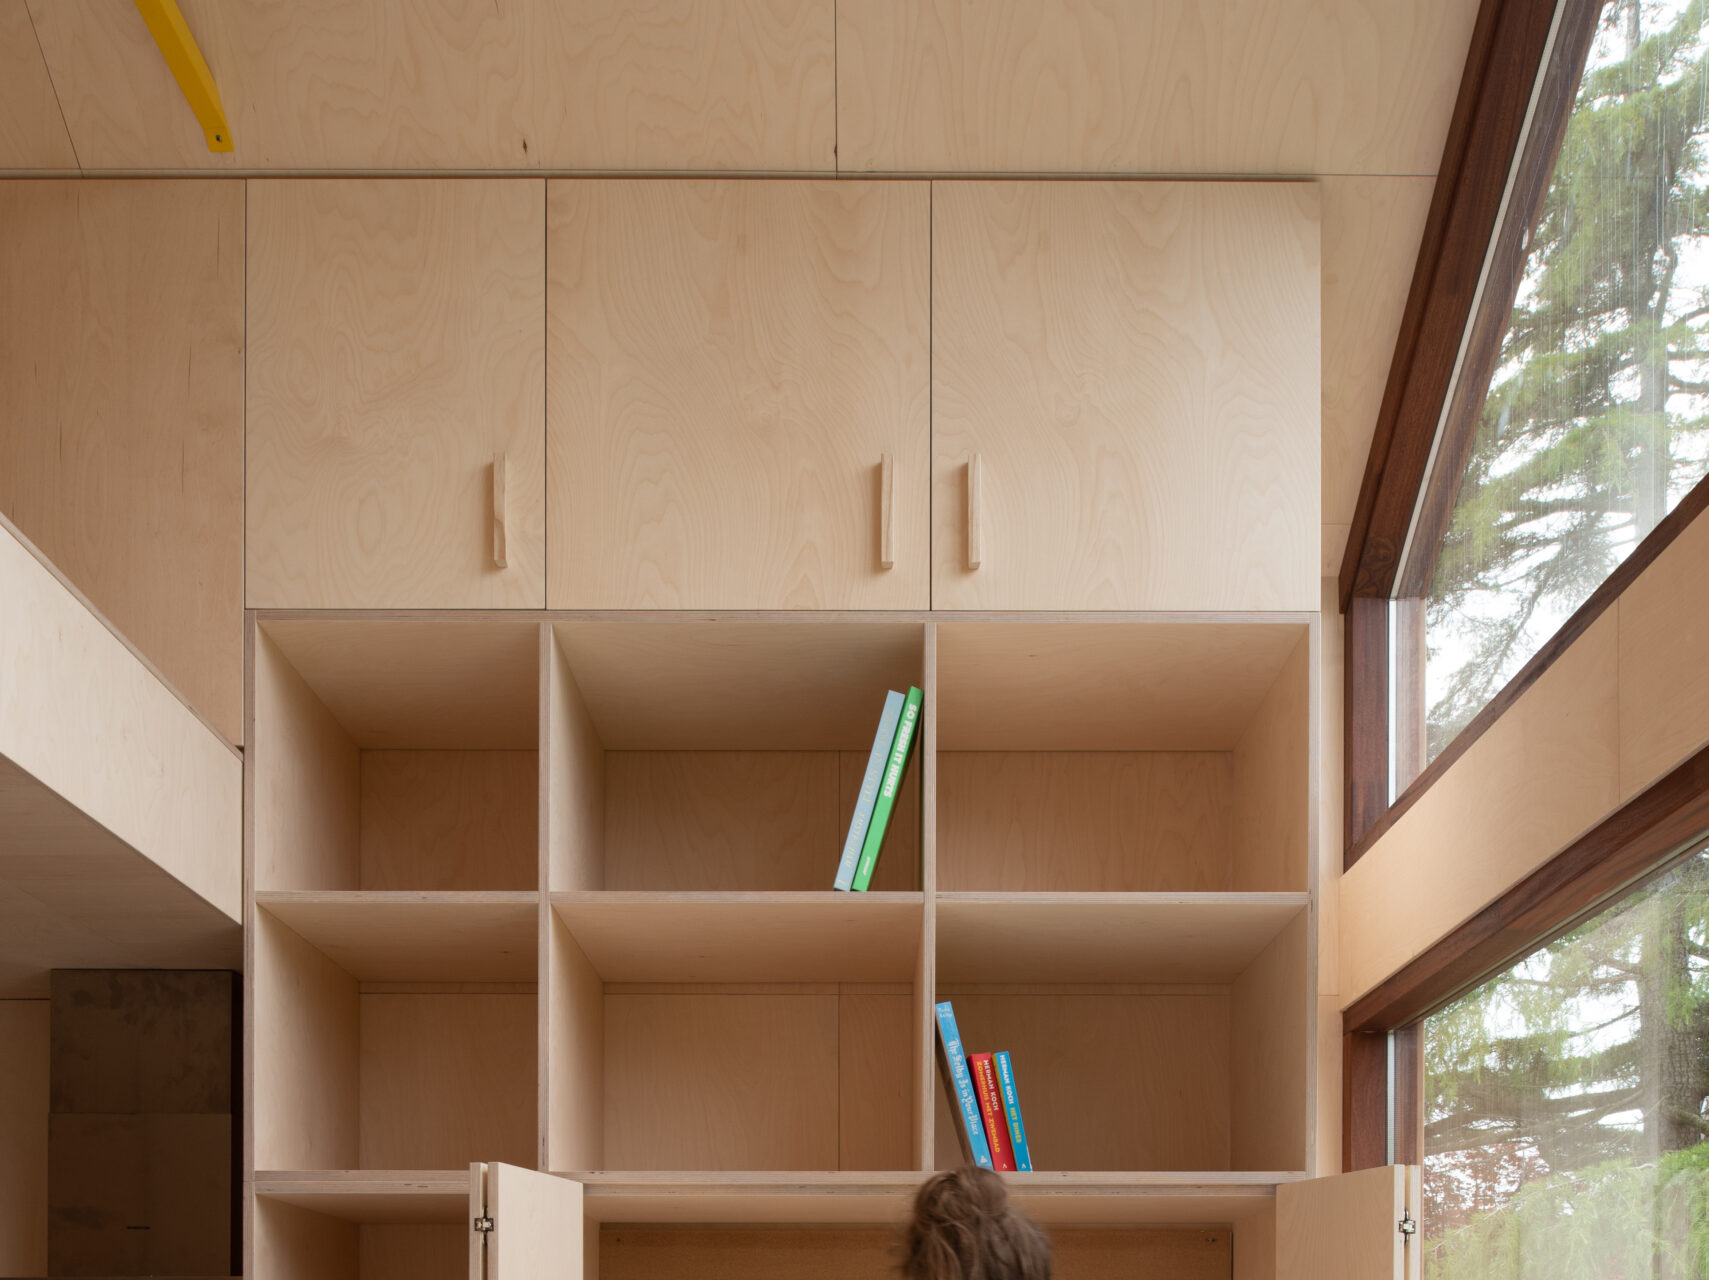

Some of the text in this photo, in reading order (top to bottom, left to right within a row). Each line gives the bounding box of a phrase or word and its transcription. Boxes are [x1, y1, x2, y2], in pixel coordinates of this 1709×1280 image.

[906, 703, 917, 720] SO
[896, 720, 914, 753] FRESH
[883, 763, 901, 798] HURTS
[983, 1059, 1000, 1111] HERMAN KOCH
[999, 1054, 1010, 1084] HERMAN
[1005, 1085, 1015, 1105] KOCH
[1012, 1121, 1022, 1144] DINER
[977, 1061, 990, 1101] ZOMERHUIS
[989, 1118, 1001, 1153] ZWEMBAD
